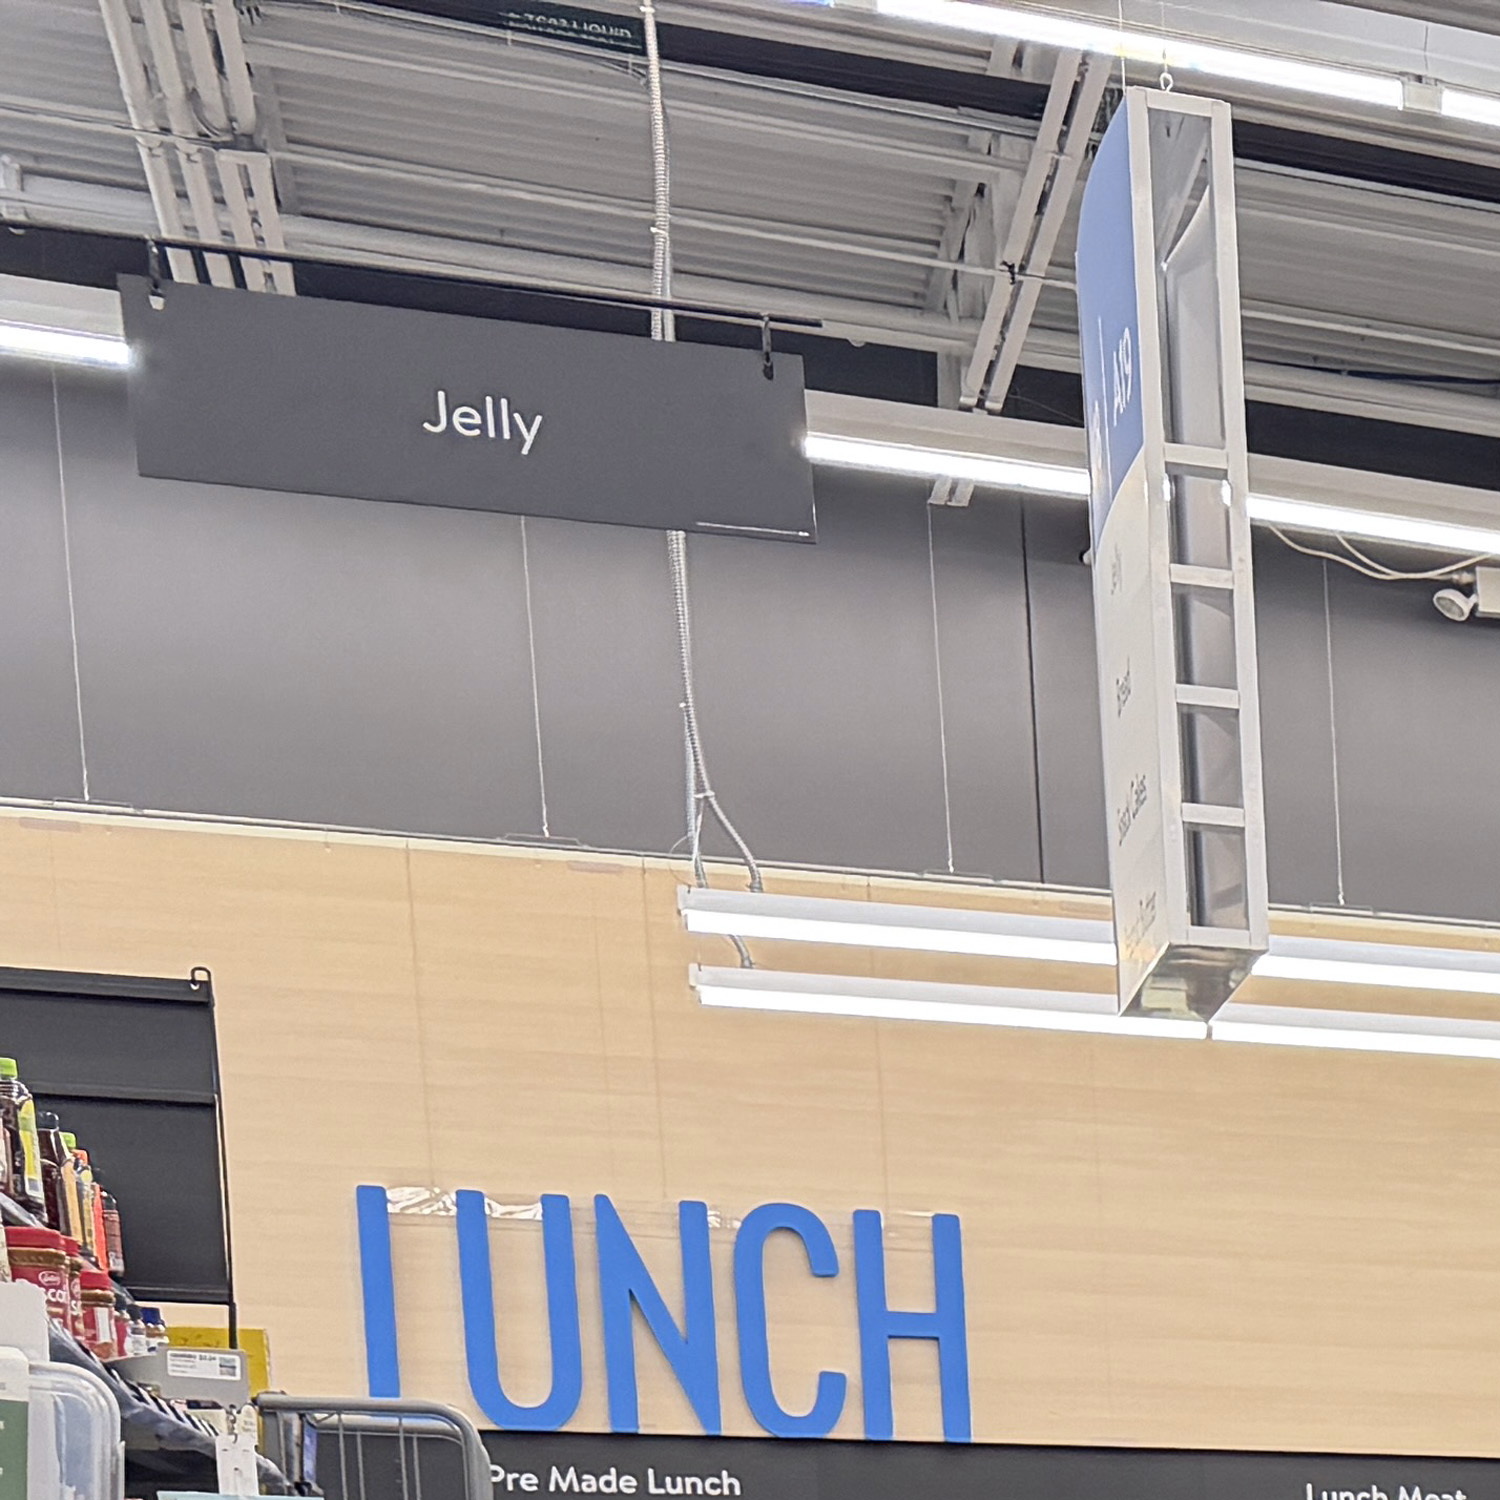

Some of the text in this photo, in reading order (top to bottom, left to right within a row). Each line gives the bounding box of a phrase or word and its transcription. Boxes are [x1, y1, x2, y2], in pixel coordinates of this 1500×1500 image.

[422, 390, 544, 456] Jelly
[488, 1464, 742, 1496] Pre Made Lunch
